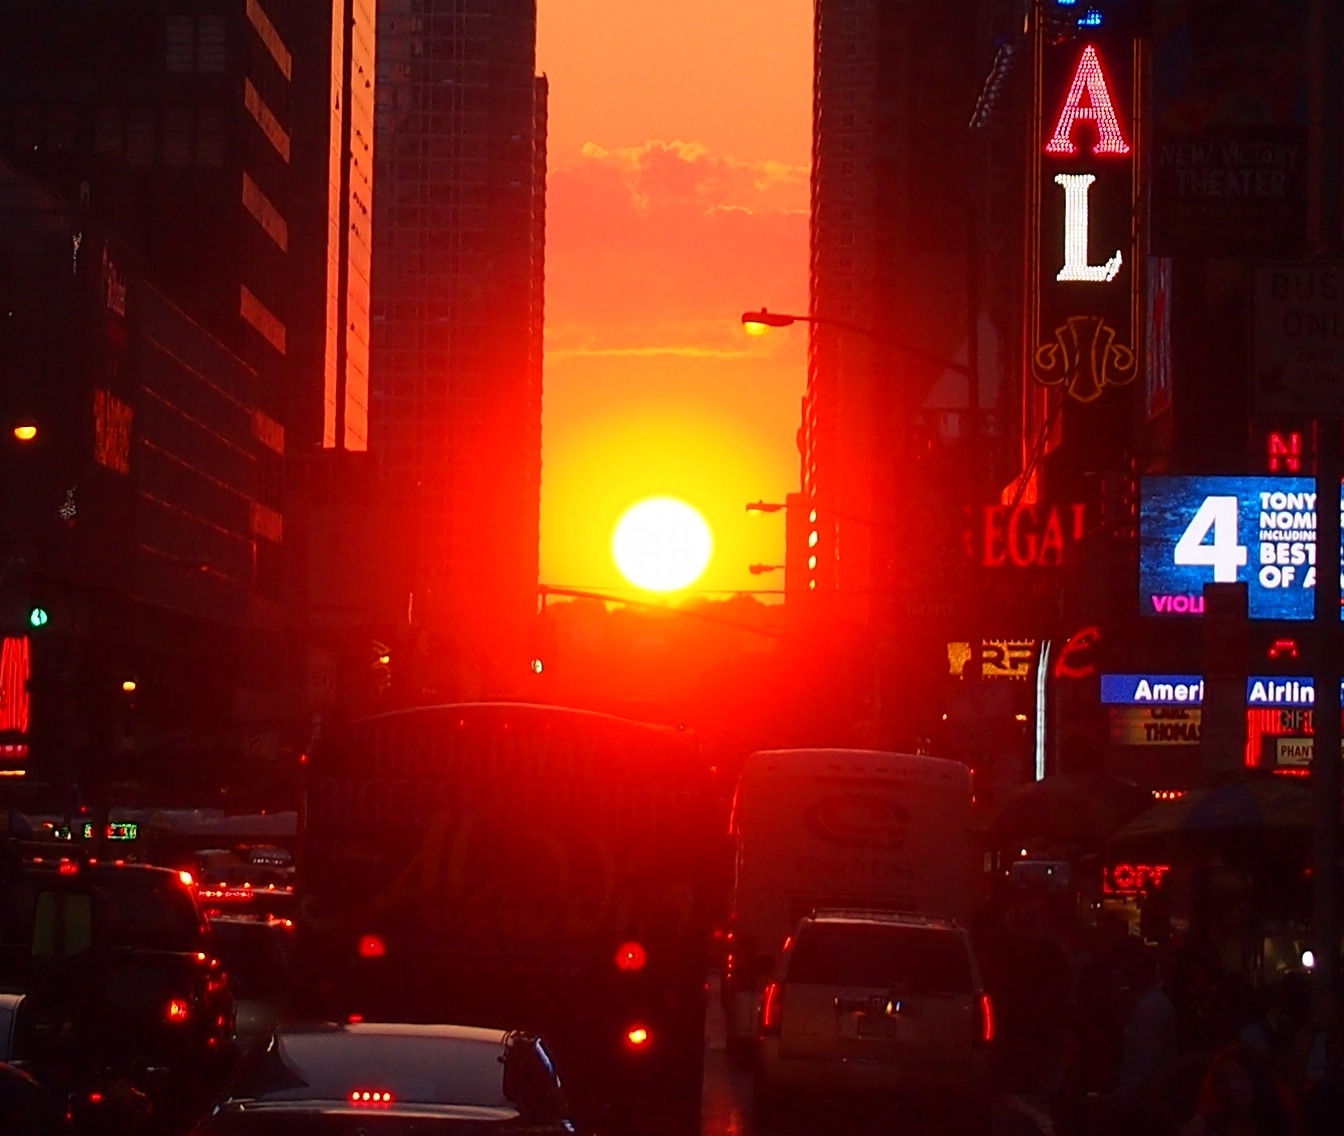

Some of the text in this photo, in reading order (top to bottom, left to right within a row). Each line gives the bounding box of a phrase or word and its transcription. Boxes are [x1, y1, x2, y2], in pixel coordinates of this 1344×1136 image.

[1259, 492, 1317, 511] TONY
[1173, 496, 1249, 583] 4
[1260, 543, 1317, 566] BEST
[1259, 565, 1296, 589] OF
